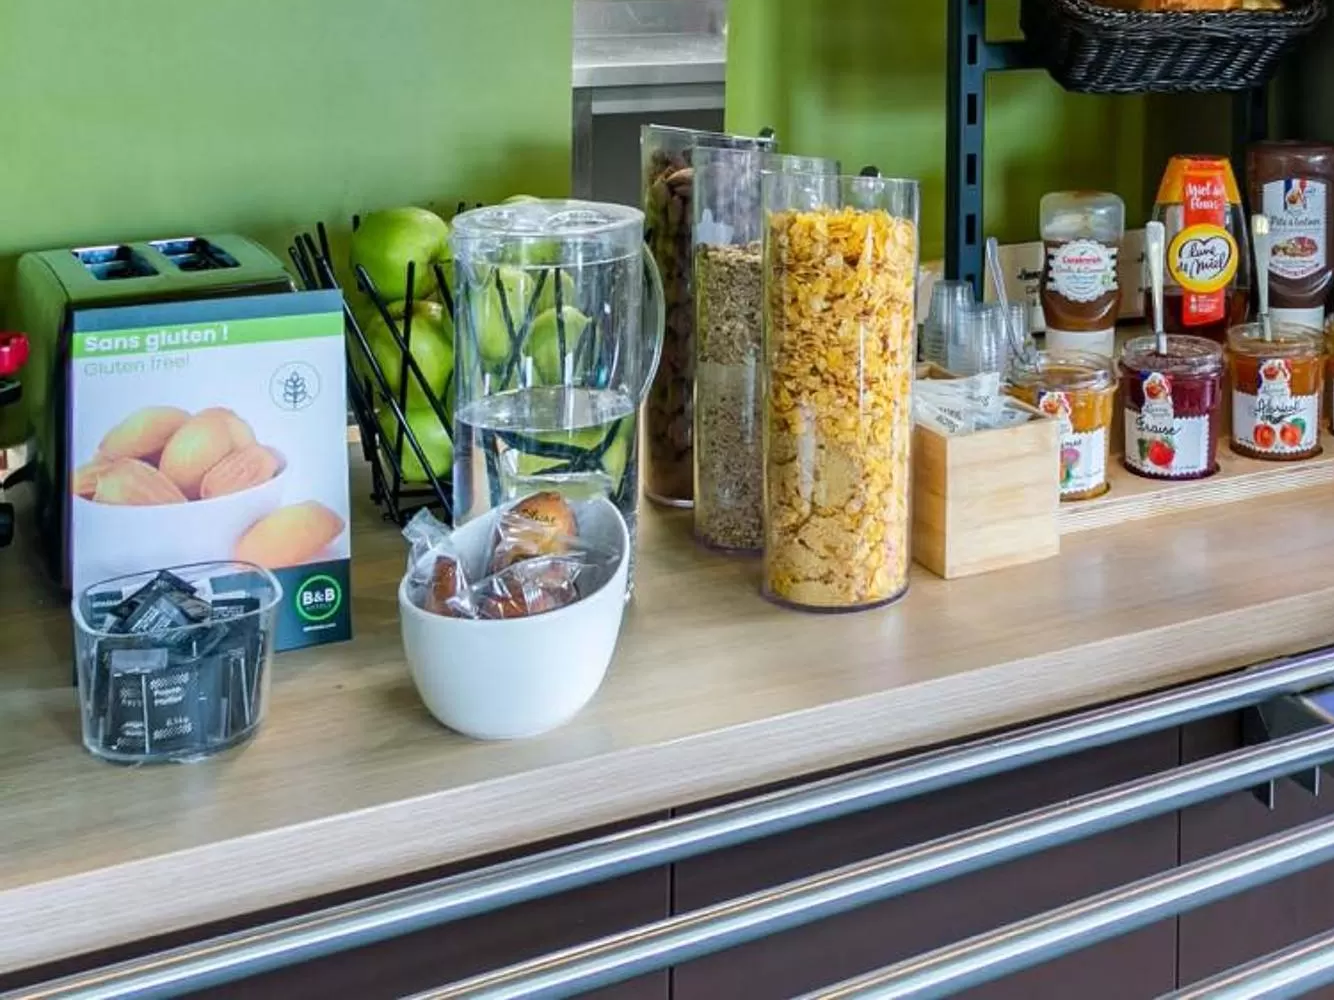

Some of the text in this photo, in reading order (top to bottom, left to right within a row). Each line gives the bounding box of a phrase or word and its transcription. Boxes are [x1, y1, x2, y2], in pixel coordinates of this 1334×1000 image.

[84, 334, 141, 351] Sans
[145, 327, 217, 353] gluten
[84, 358, 145, 376] Gluten
[303, 587, 335, 606] B&B
